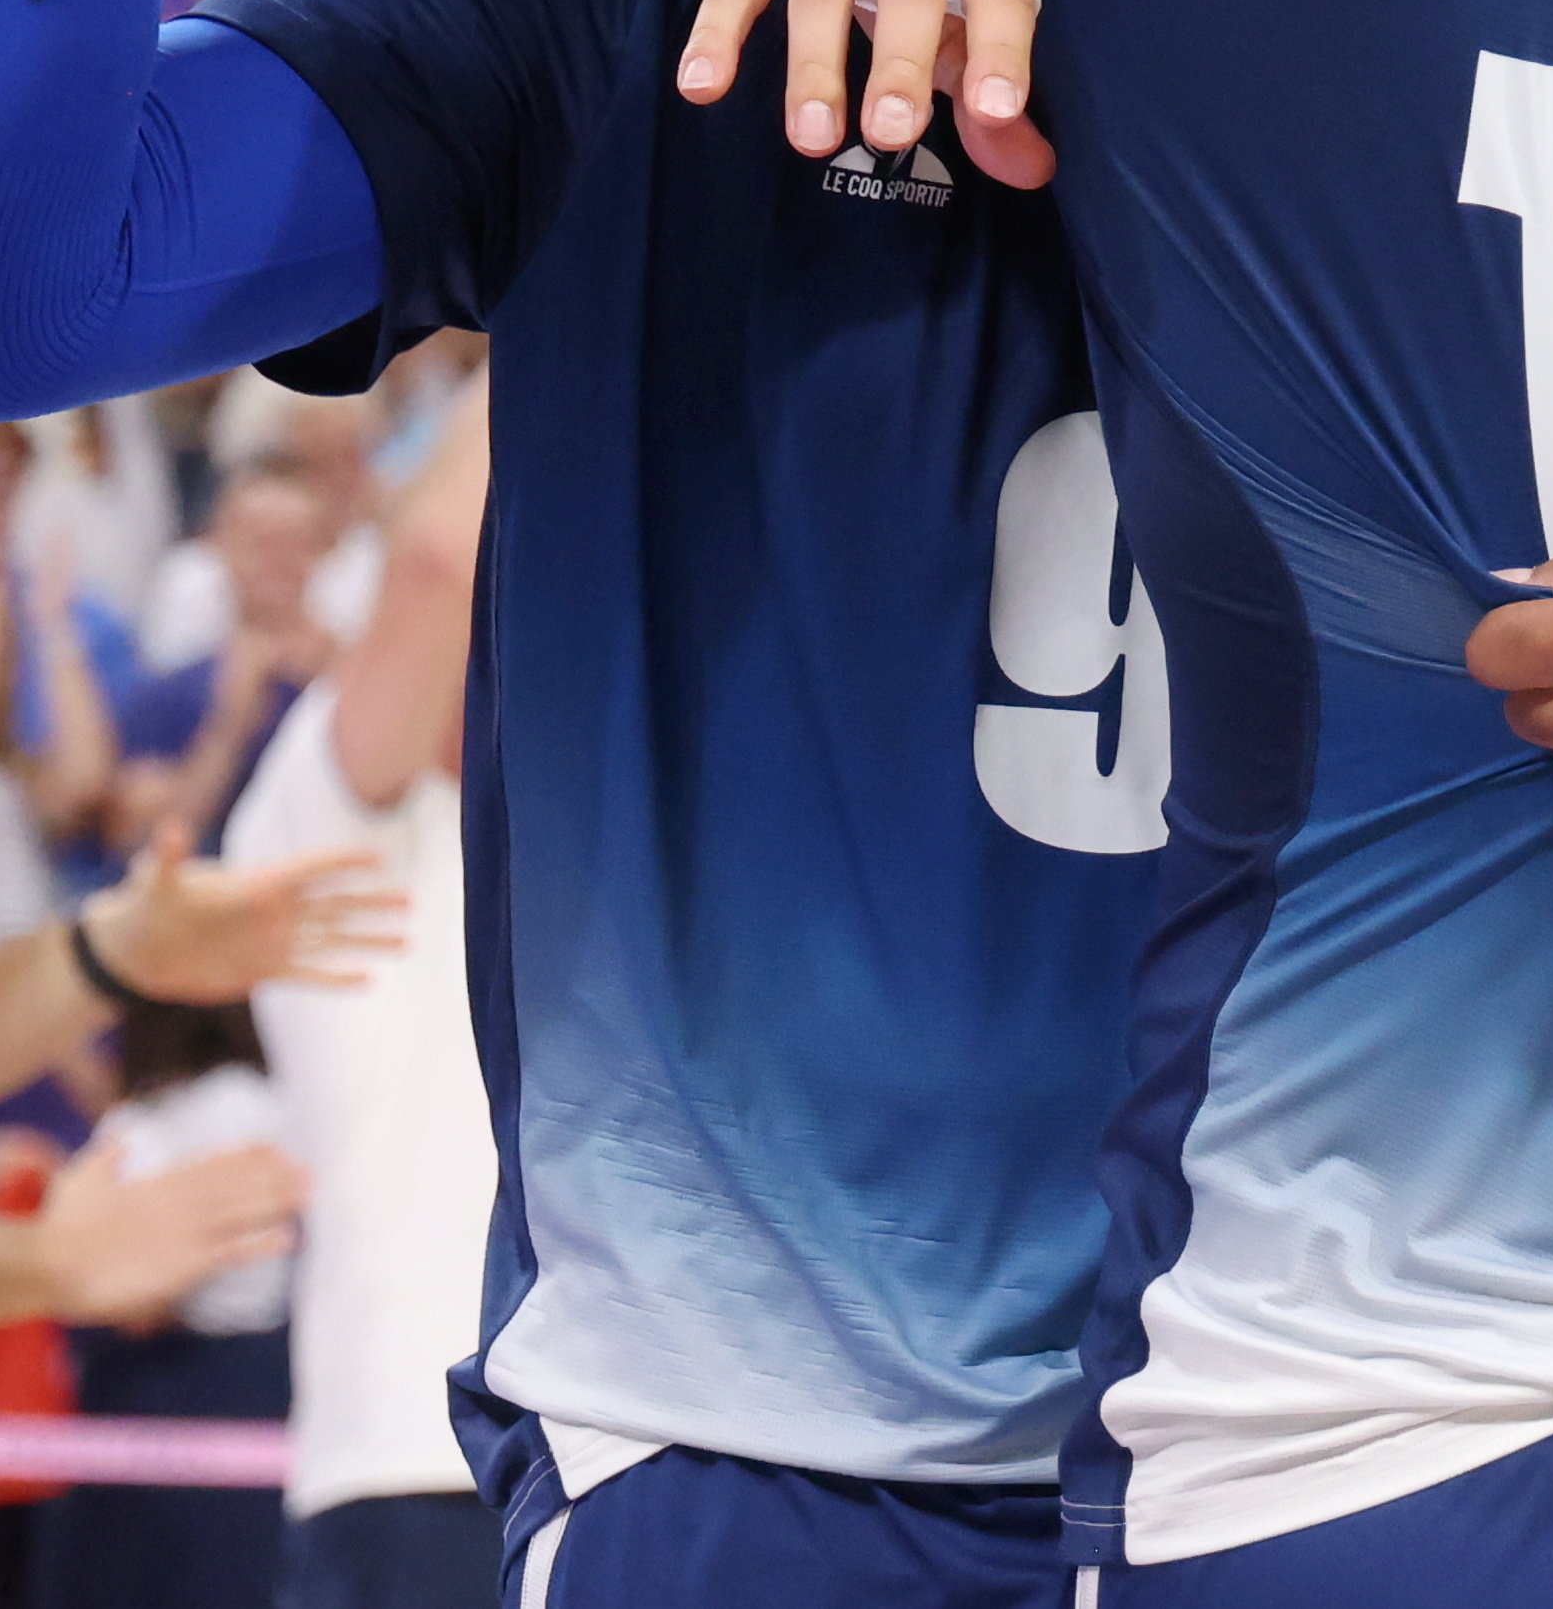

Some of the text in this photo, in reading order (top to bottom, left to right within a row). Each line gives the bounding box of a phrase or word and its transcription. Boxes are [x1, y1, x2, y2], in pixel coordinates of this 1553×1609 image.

[822, 169, 952, 208] LE COQ SPORTIF
[973, 410, 1172, 854] 9
